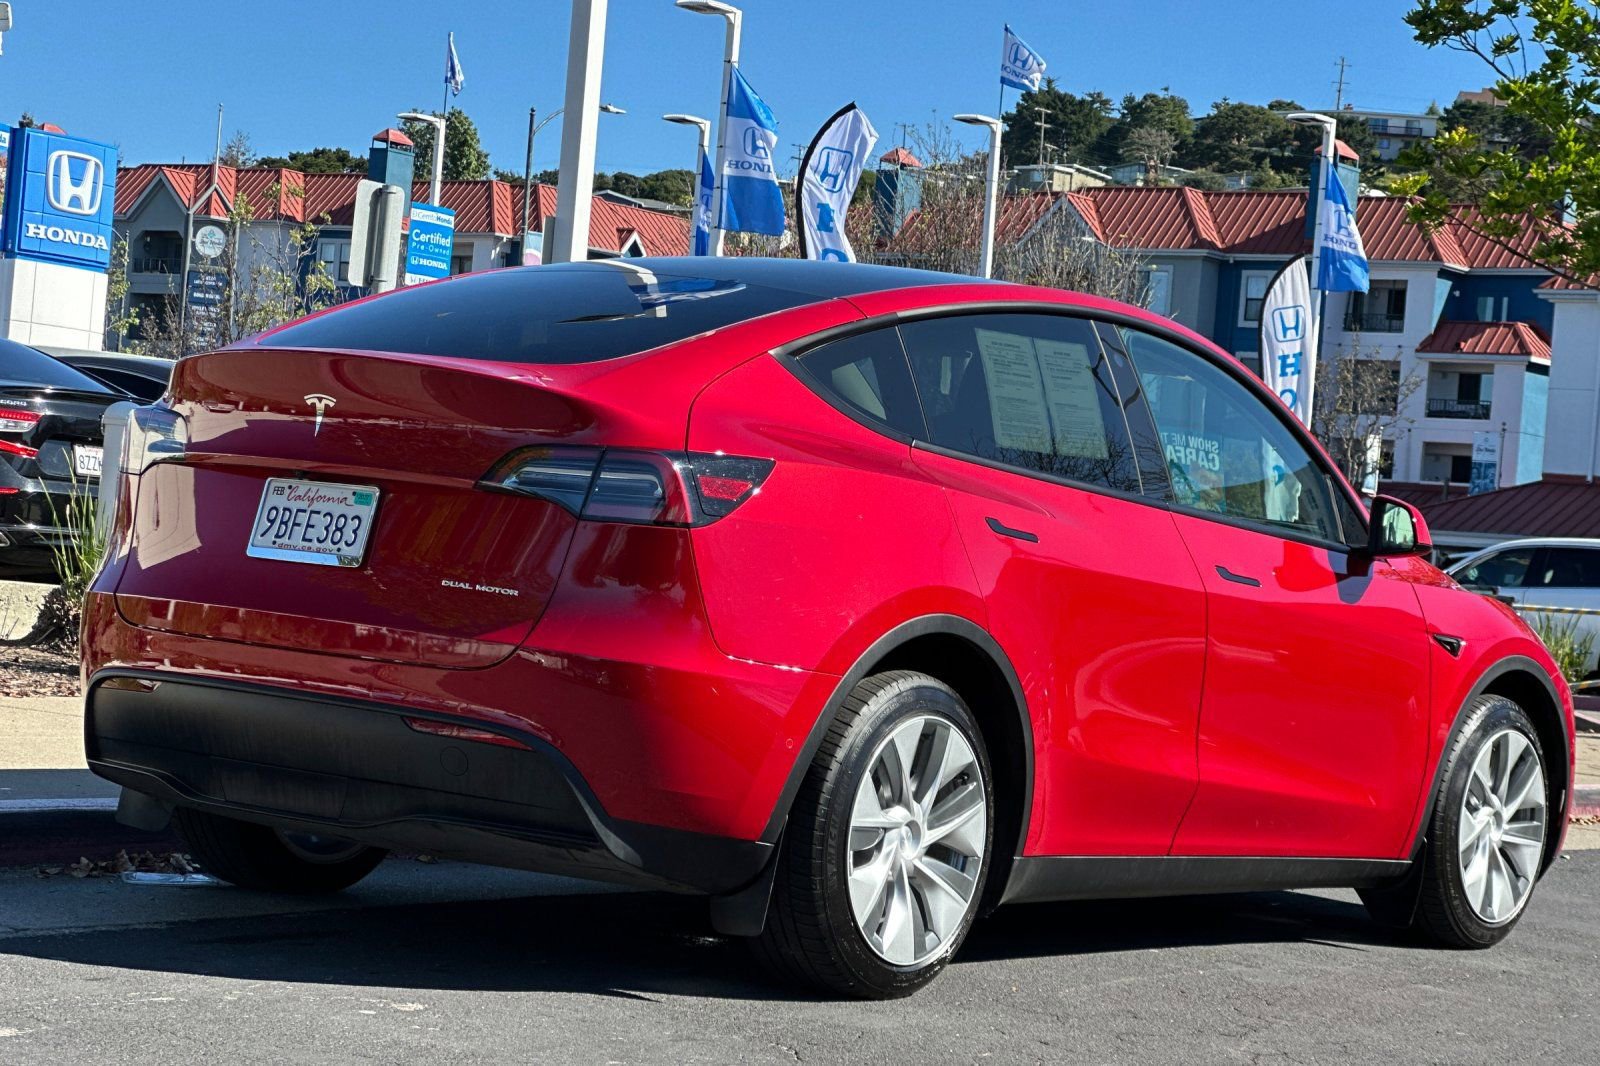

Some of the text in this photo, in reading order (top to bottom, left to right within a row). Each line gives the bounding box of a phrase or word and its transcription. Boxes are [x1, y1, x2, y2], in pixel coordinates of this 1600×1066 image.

[25, 223, 109, 251] HONDA
[412, 229, 451, 247] Certified
[412, 241, 450, 256] Pre-Owned
[419, 258, 448, 270] HONDA
[272, 485, 286, 496] FEB
[287, 485, 354, 508] California
[259, 505, 362, 548] 9BFE383
[277, 542, 334, 553] dmv.ca.gov
[441, 579, 519, 596] DUAL MOTOR
